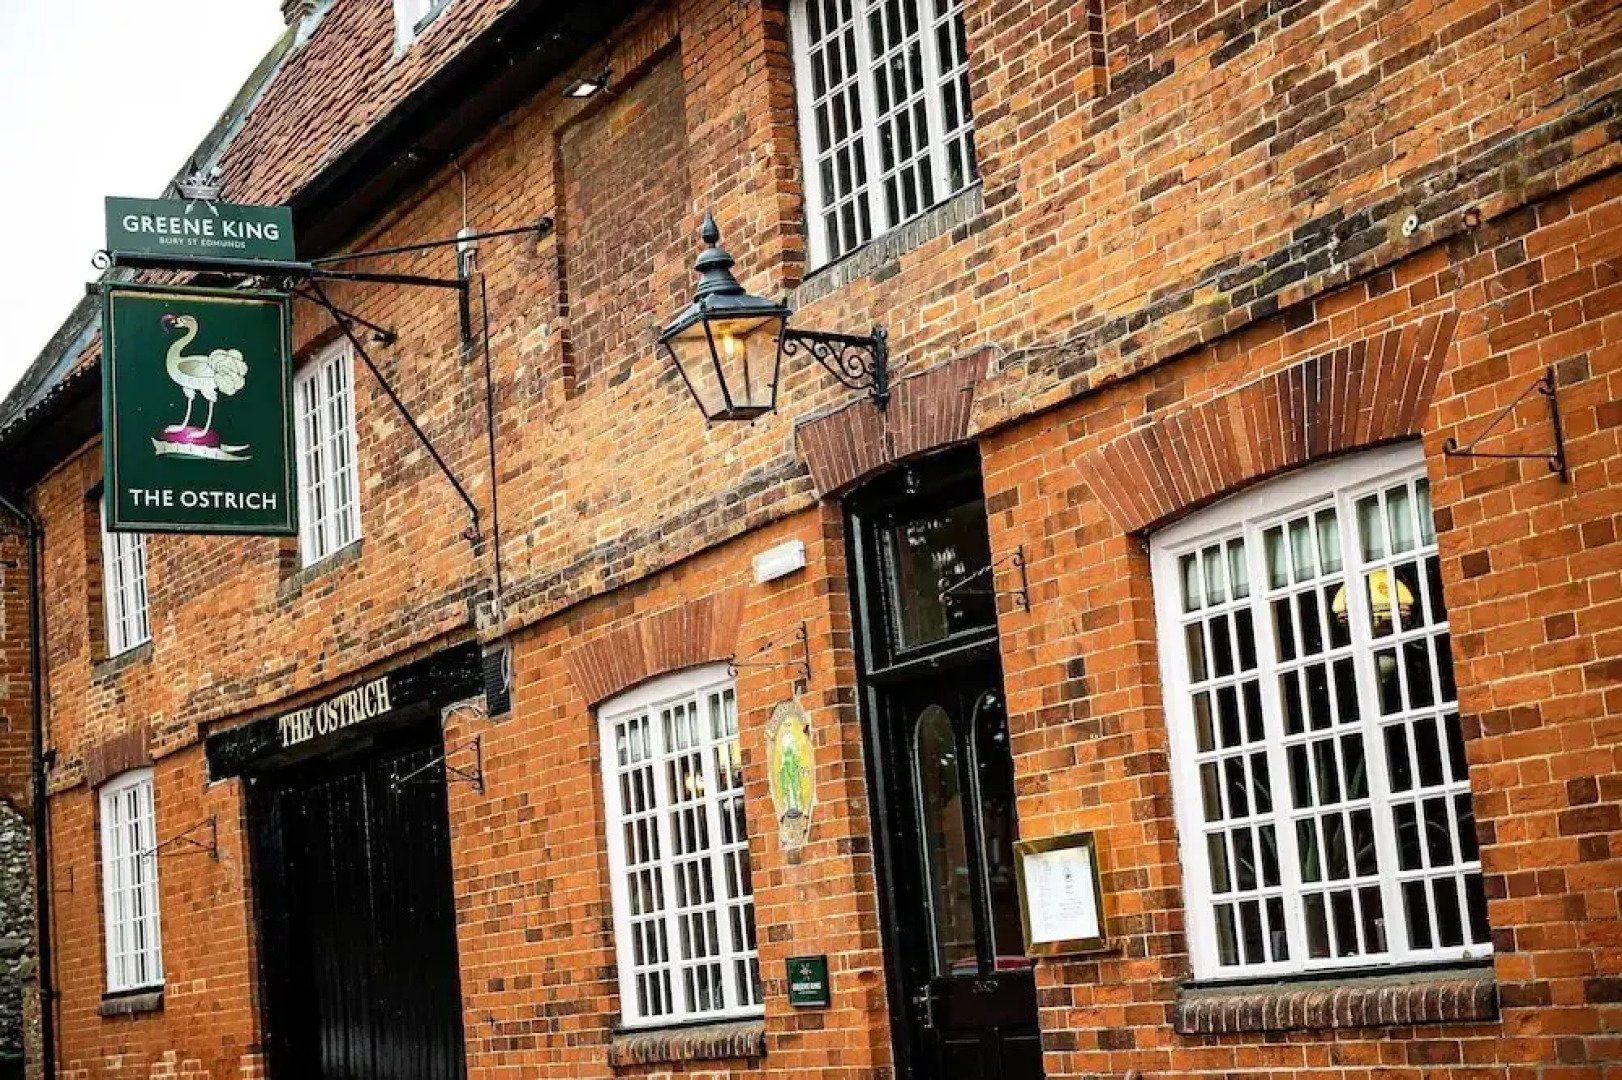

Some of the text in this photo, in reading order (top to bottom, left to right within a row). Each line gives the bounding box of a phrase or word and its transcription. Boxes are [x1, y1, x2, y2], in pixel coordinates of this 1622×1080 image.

[122, 214, 280, 241] GREENE KING
[159, 236, 246, 249] BURY ST EDMUNDS
[129, 489, 277, 510] THE OSTRICH
[279, 676, 392, 747] THE OSTRICH
